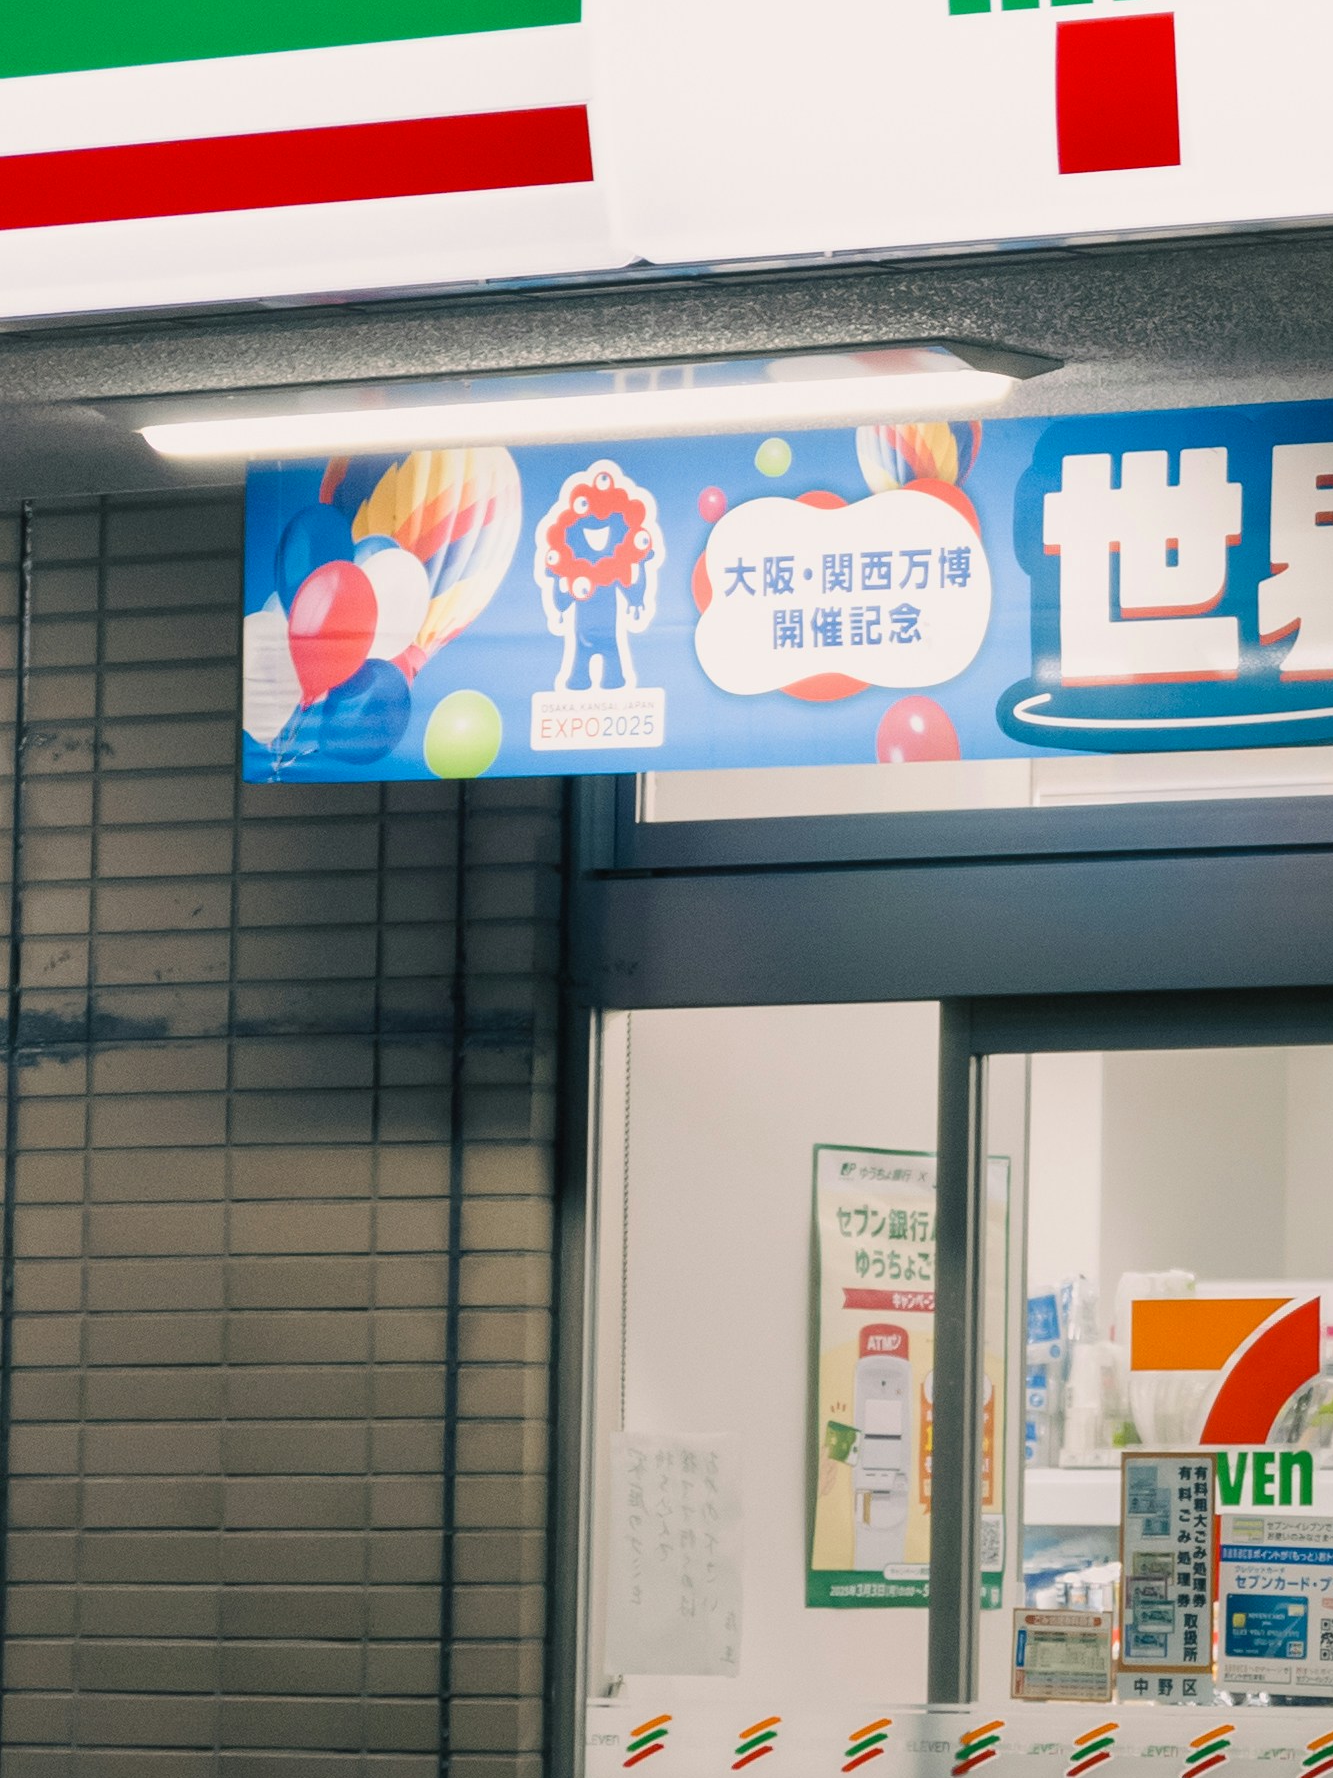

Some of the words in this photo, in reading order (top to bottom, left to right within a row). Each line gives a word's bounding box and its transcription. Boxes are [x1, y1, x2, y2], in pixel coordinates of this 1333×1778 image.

[723, 545, 973, 598] 大阪・関西万博
[772, 602, 924, 651] 開催記念
[622, 700, 655, 711] JAPAN
[855, 1249, 937, 1281] ゆうちょご
[1217, 1450, 1314, 1506] VEn
[1177, 1465, 1192, 1609] 有料ごみ処理券
[1133, 1677, 1199, 1697] 中野区
